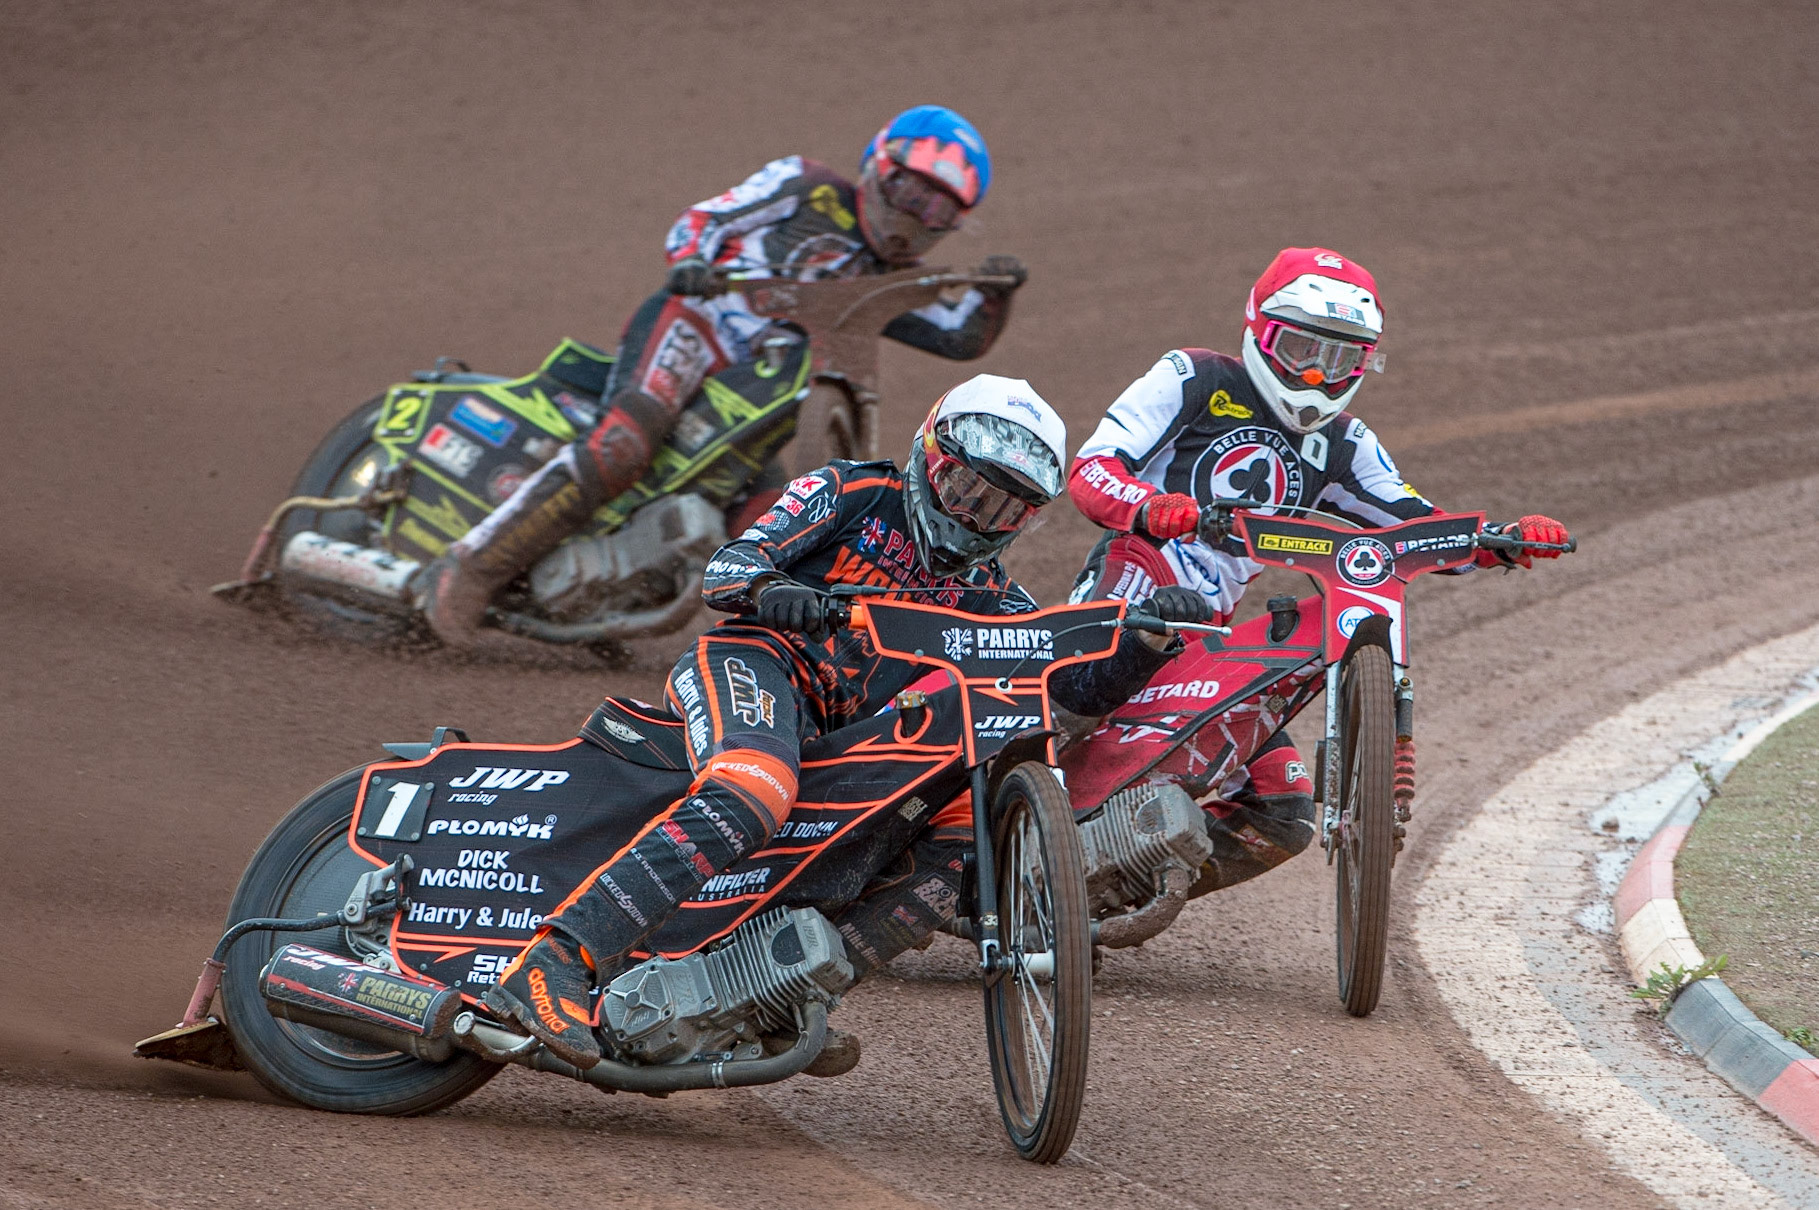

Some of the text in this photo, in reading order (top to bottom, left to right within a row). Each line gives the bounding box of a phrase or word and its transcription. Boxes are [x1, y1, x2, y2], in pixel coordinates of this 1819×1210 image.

[387, 397, 421, 429] 2
[1213, 430, 1298, 498] BELLE VUE ACES
[1281, 538, 1327, 552] ENTRACK
[976, 628, 1054, 650] PARRYS
[1127, 679, 1220, 704] BETARD
[674, 667, 709, 757] Harry & Jules
[974, 715, 1041, 730] JWP
[978, 729, 1007, 739] racing
[448, 766, 571, 792] JWP
[374, 781, 421, 838] 1
[448, 790, 499, 806] racing
[457, 849, 510, 870] DICK
[662, 818, 716, 877] SHARP
[419, 868, 544, 895] MCNICOLL
[701, 867, 771, 892] NIFILTER
[689, 885, 765, 902] USTRALIA
[407, 902, 472, 930] Harry
[476, 906, 493, 927] &
[355, 992, 423, 1019] INTERNATIONAL
[358, 976, 433, 1011] PARRYS
[528, 966, 571, 1035] daytona
